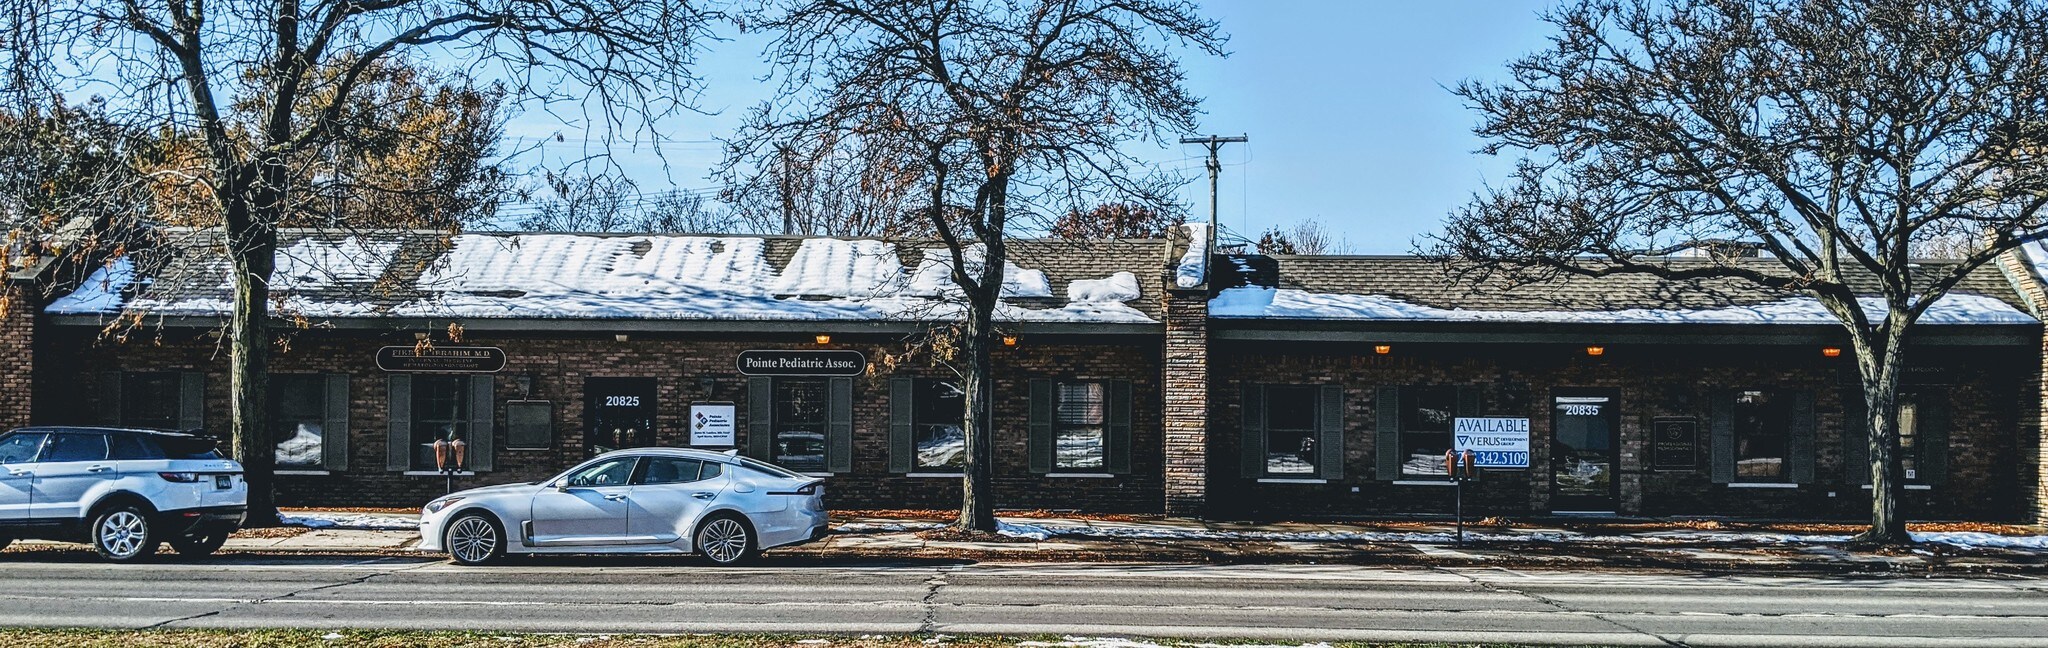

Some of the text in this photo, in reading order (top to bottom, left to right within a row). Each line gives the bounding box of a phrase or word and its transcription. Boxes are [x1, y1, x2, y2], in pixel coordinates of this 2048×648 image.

[746, 357, 856, 368] Pointe Pediatric Assoc.
[606, 396, 640, 406] 20825
[1565, 405, 1599, 415] 20835
[1457, 419, 1528, 432] AVAILABLE
[1469, 437, 1501, 446] VERUS
[1457, 452, 1527, 464] 2.342.5109
